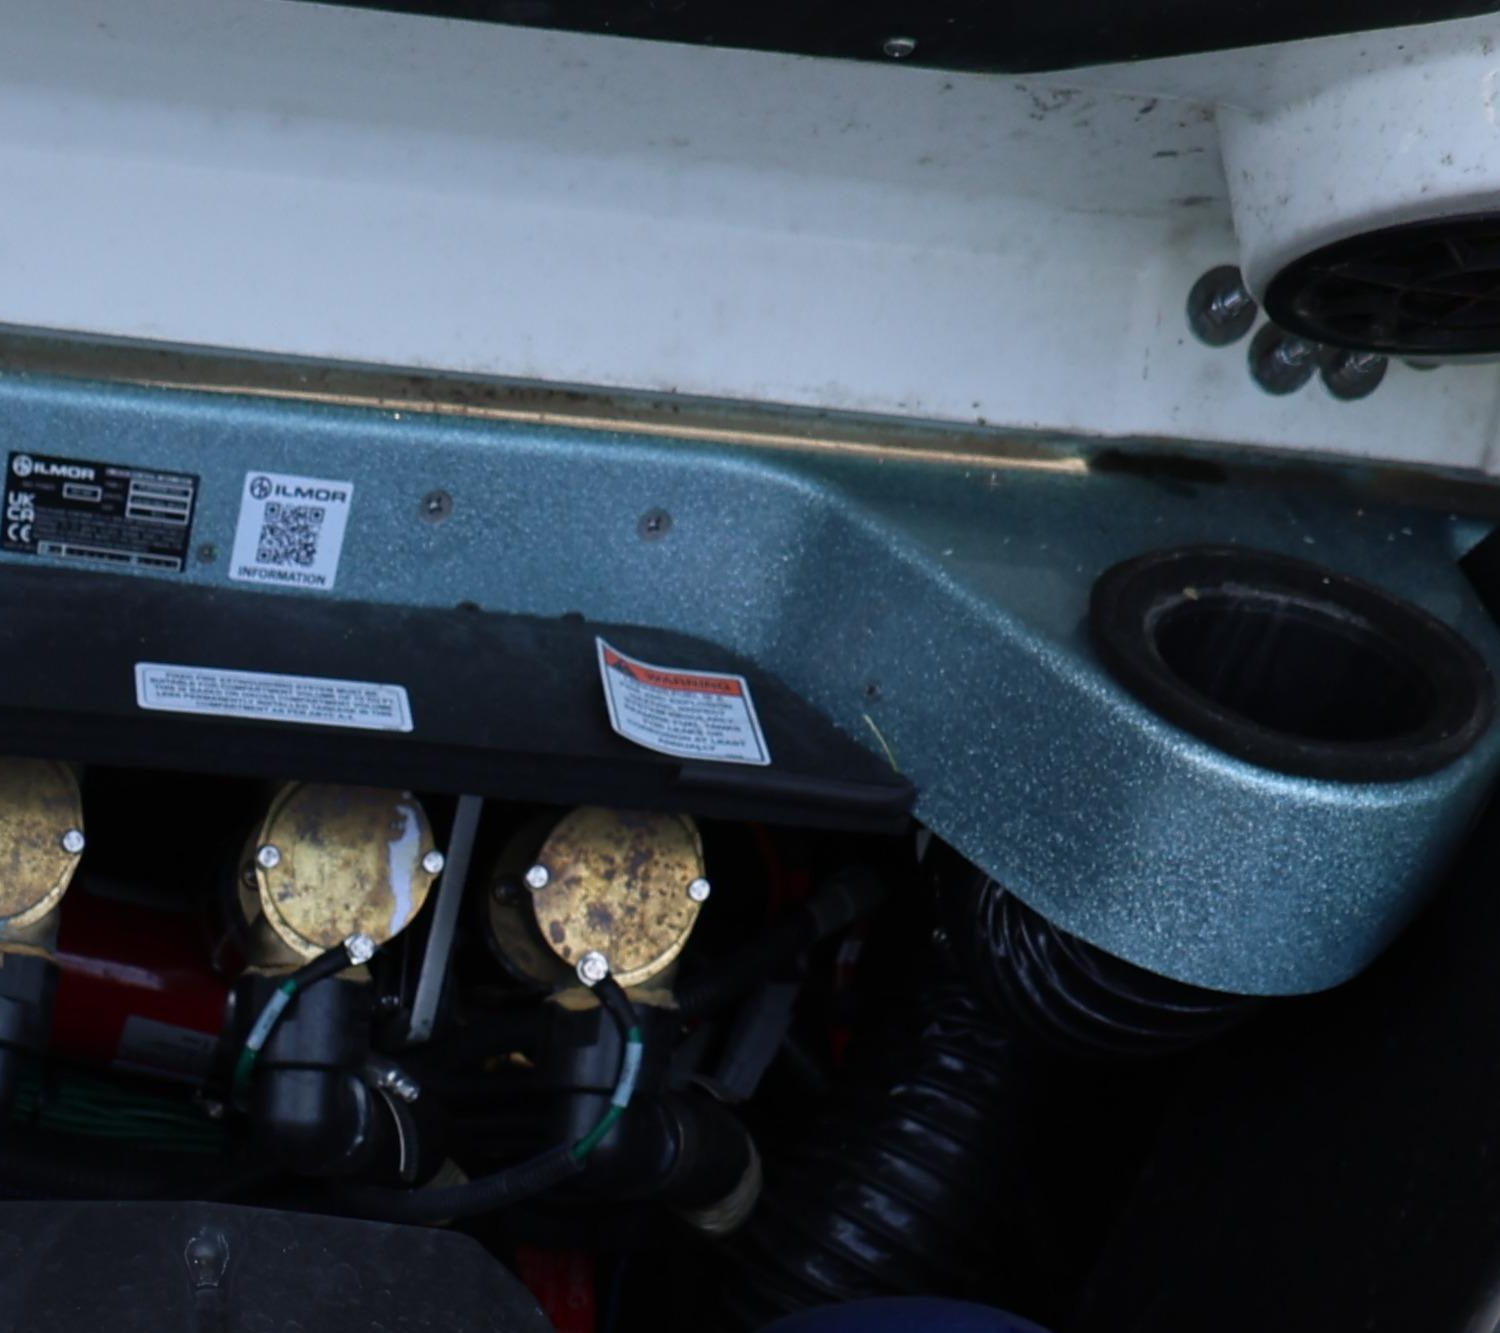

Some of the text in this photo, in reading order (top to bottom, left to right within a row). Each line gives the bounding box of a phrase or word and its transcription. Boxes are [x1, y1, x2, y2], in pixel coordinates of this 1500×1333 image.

[34, 462, 95, 481] ILMOR
[274, 485, 348, 504] ILMOR
[237, 566, 327, 586] INFORMATION
